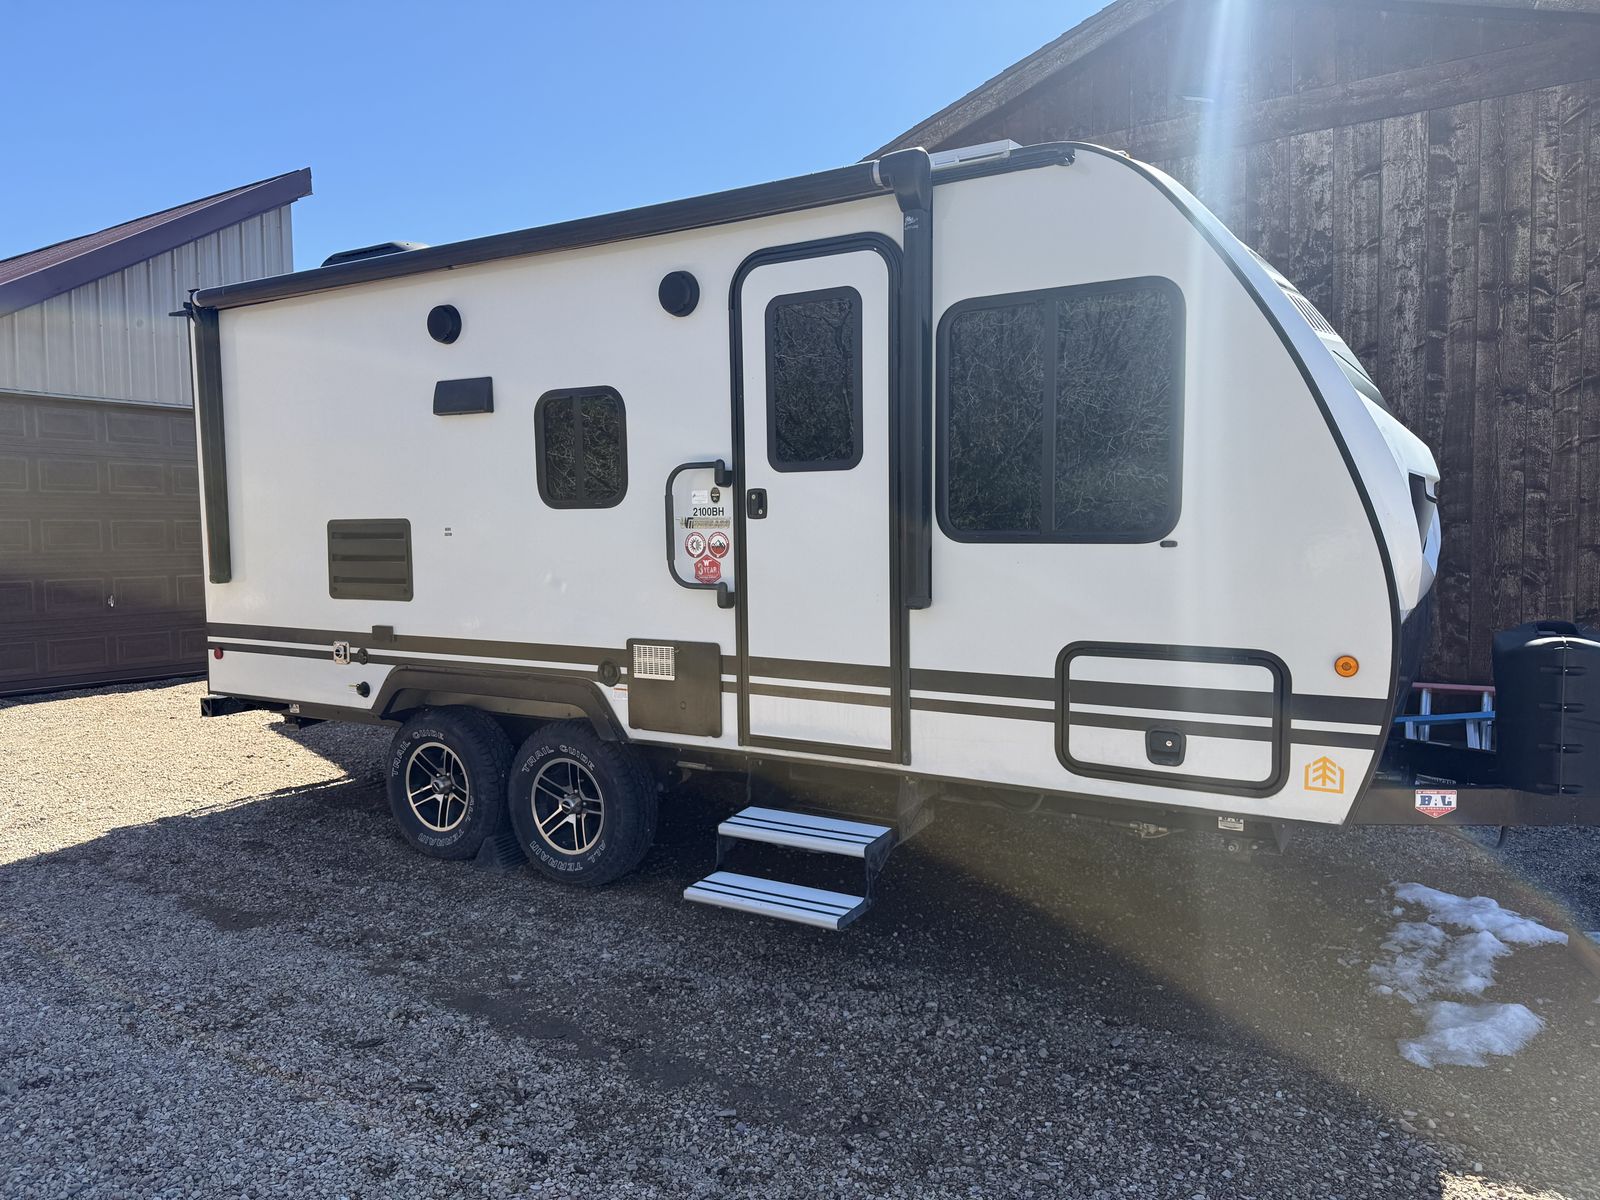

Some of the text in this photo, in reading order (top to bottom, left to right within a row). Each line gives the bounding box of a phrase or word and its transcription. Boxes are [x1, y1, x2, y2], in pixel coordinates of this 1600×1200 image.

[692, 506, 725, 517] 2100BH
[697, 562, 704, 576] 3
[391, 728, 445, 777] TRAIL GUIDE
[521, 744, 596, 773] TRAIL GUIDE
[417, 795, 475, 847] ALL TERRAIN
[529, 840, 607, 872] ALL TERRAIN
